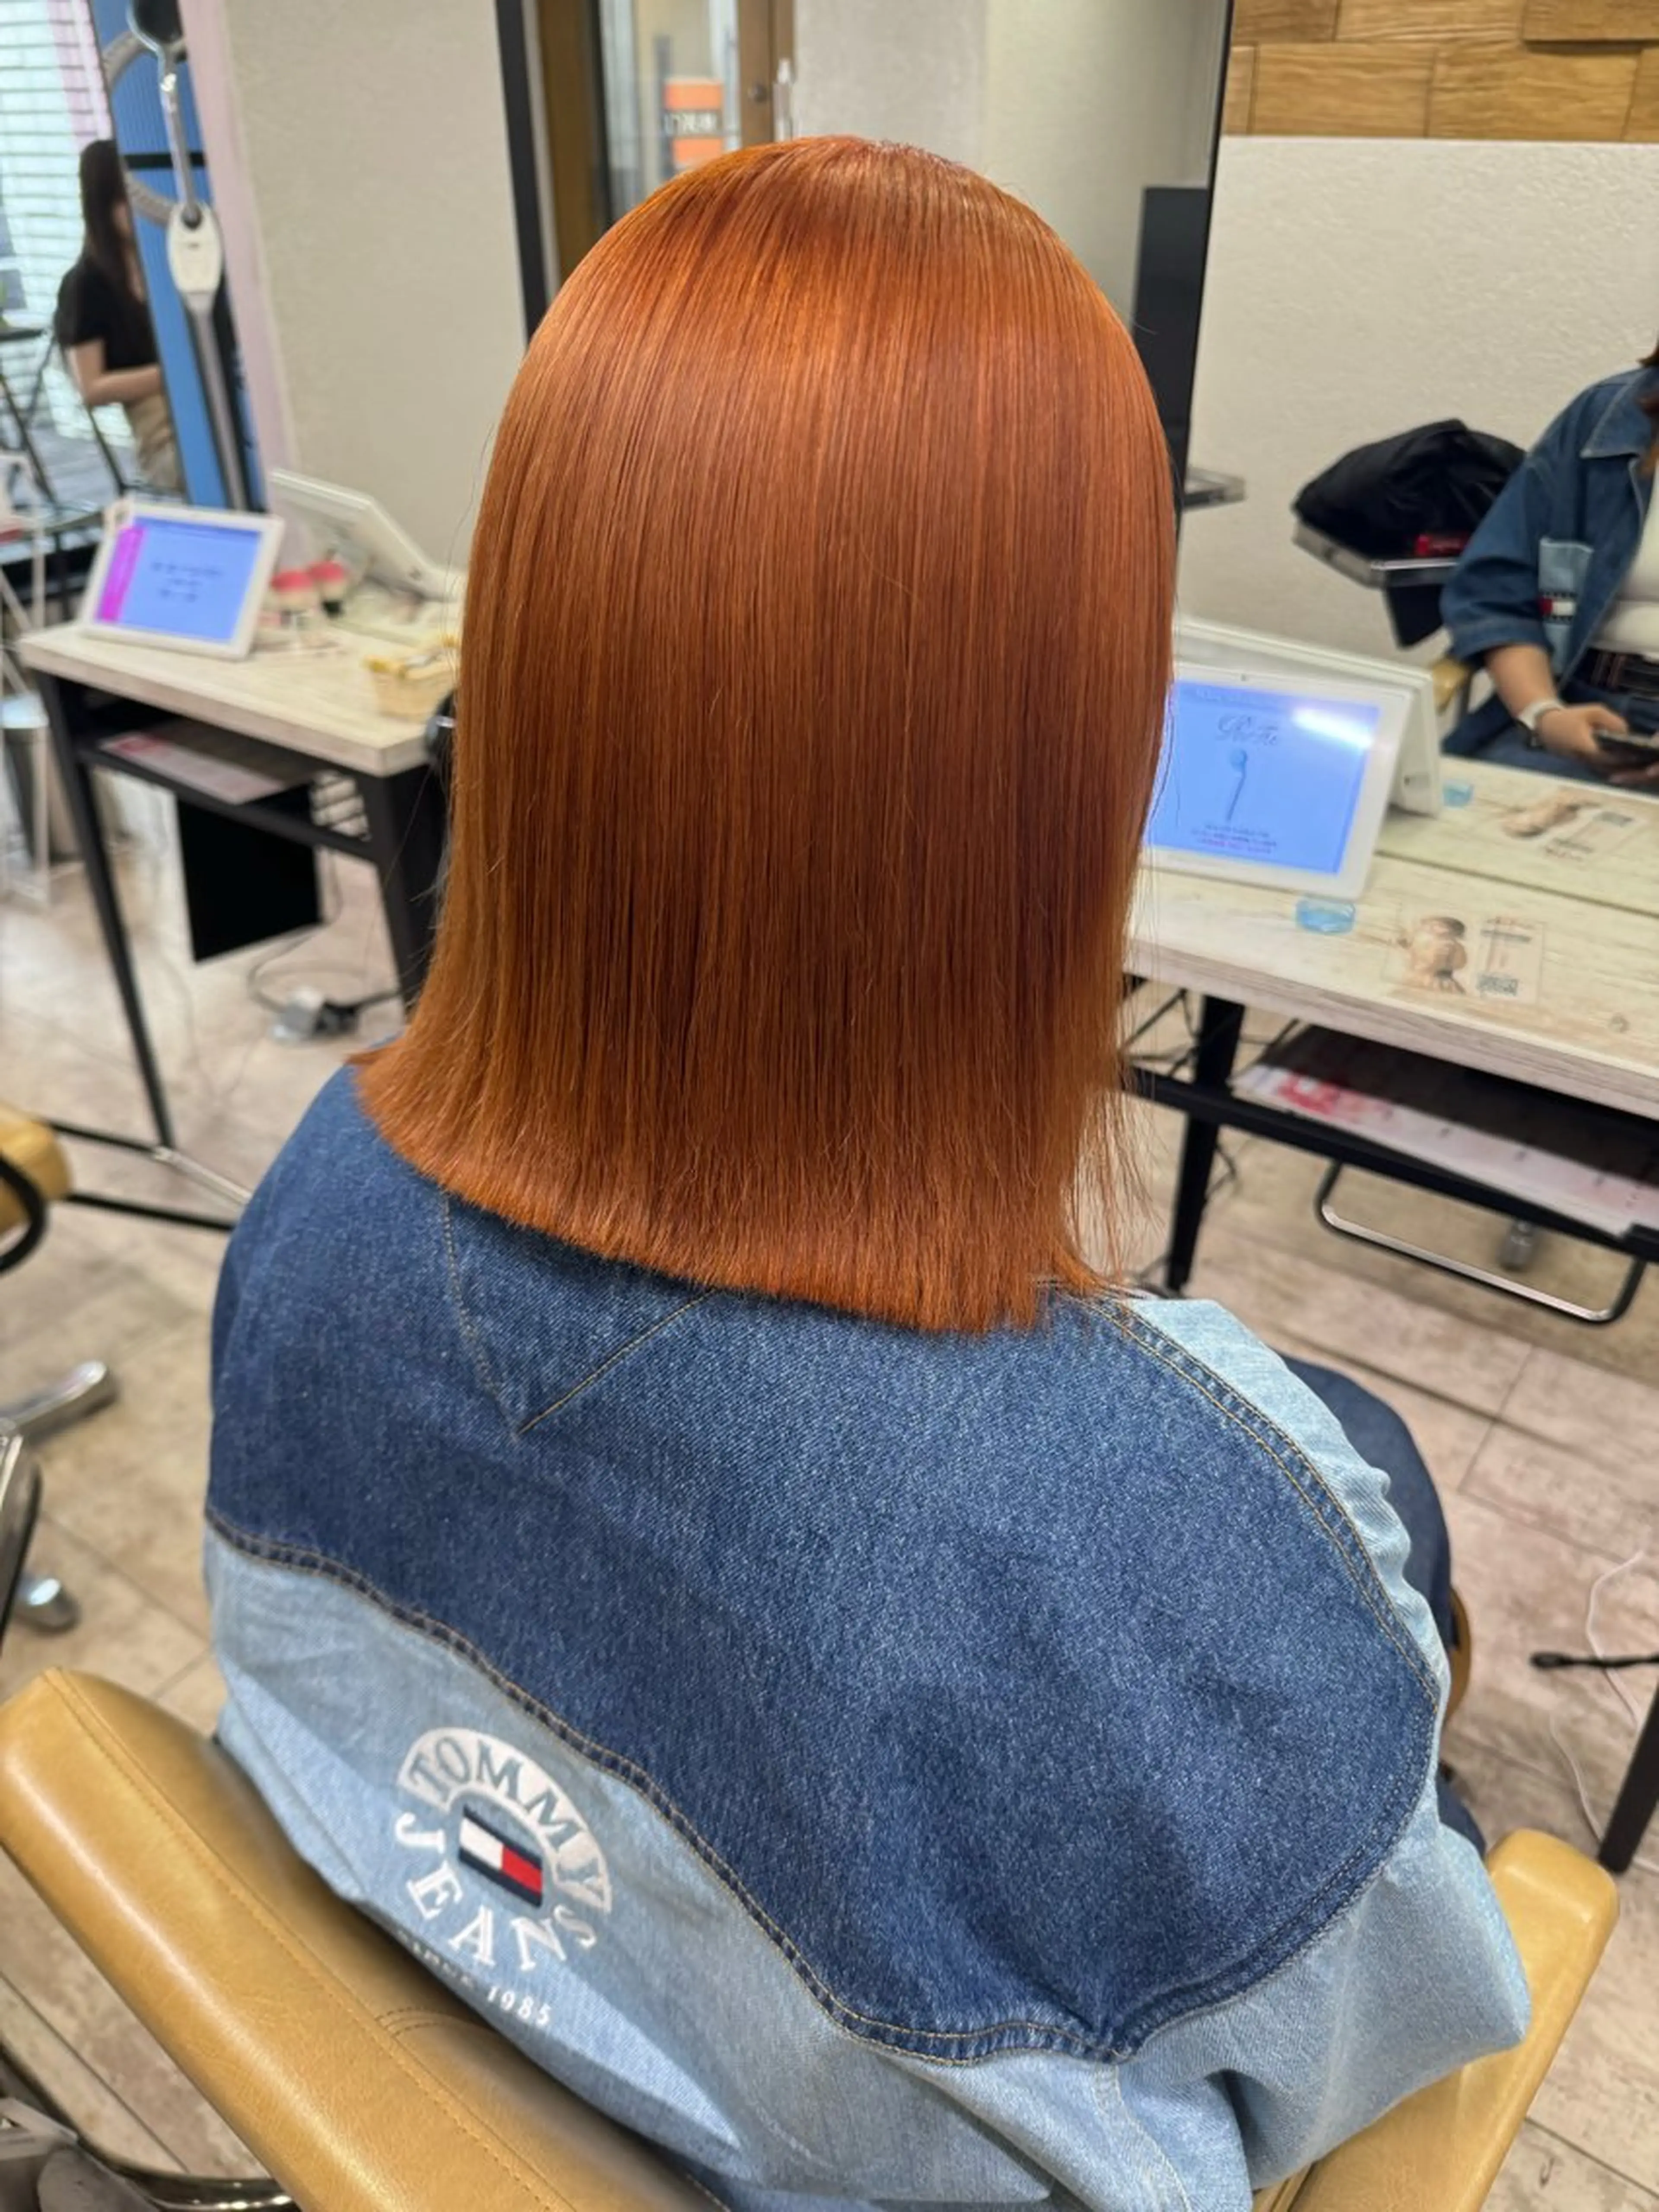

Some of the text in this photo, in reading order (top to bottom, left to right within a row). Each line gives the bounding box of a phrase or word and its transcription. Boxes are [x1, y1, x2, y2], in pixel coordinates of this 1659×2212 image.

[395, 1812, 598, 1971] JEANS
[408, 1736, 606, 1903] TOMMY
[487, 1985, 551, 2028] 1985
